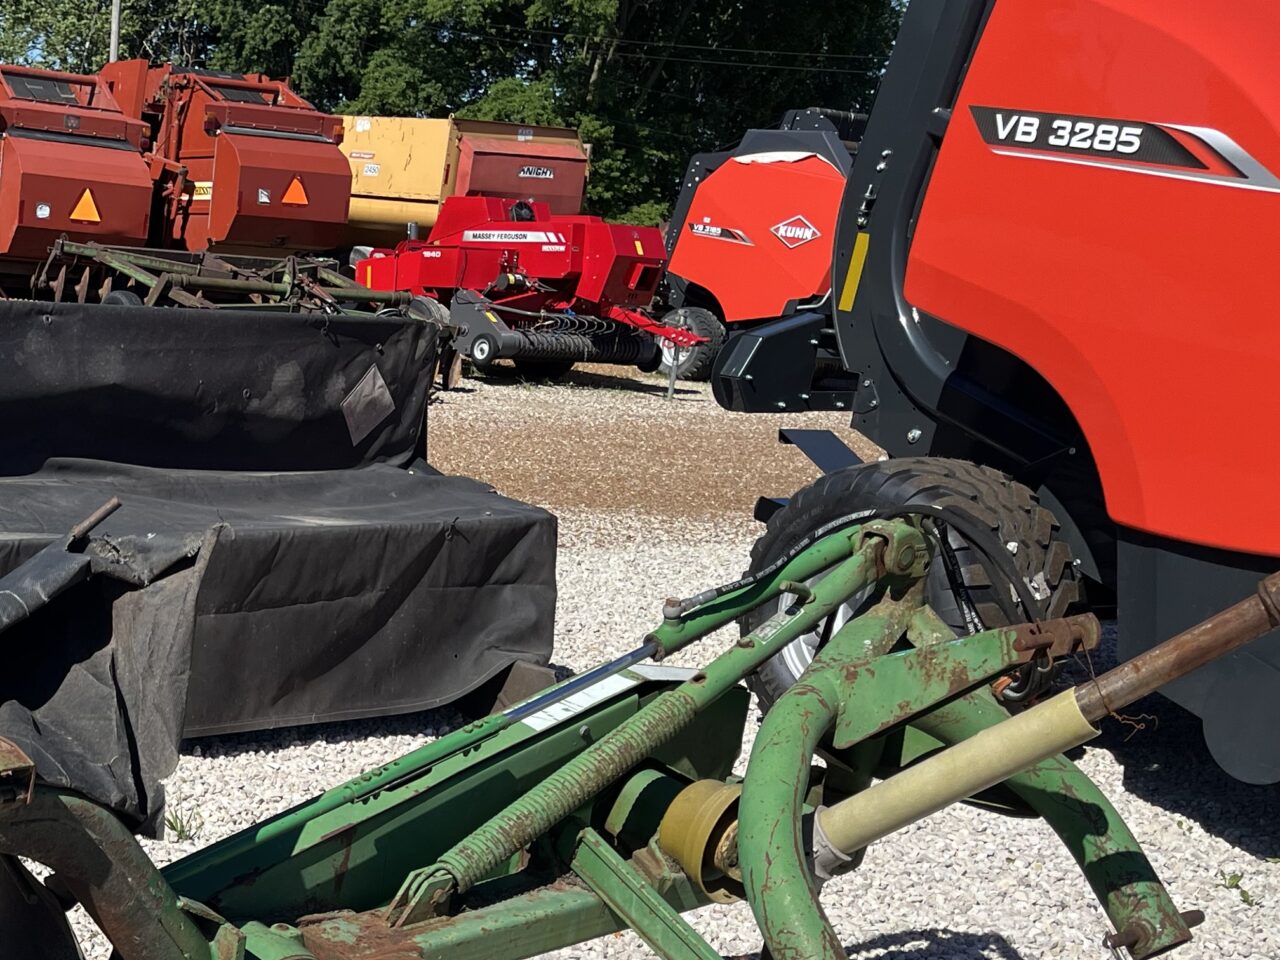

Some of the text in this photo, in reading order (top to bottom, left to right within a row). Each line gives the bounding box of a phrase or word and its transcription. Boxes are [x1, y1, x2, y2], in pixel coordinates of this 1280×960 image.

[995, 113, 1143, 154] VB 3285
[496, 233, 527, 241] FERGUSON
[778, 225, 813, 240] KUHN
